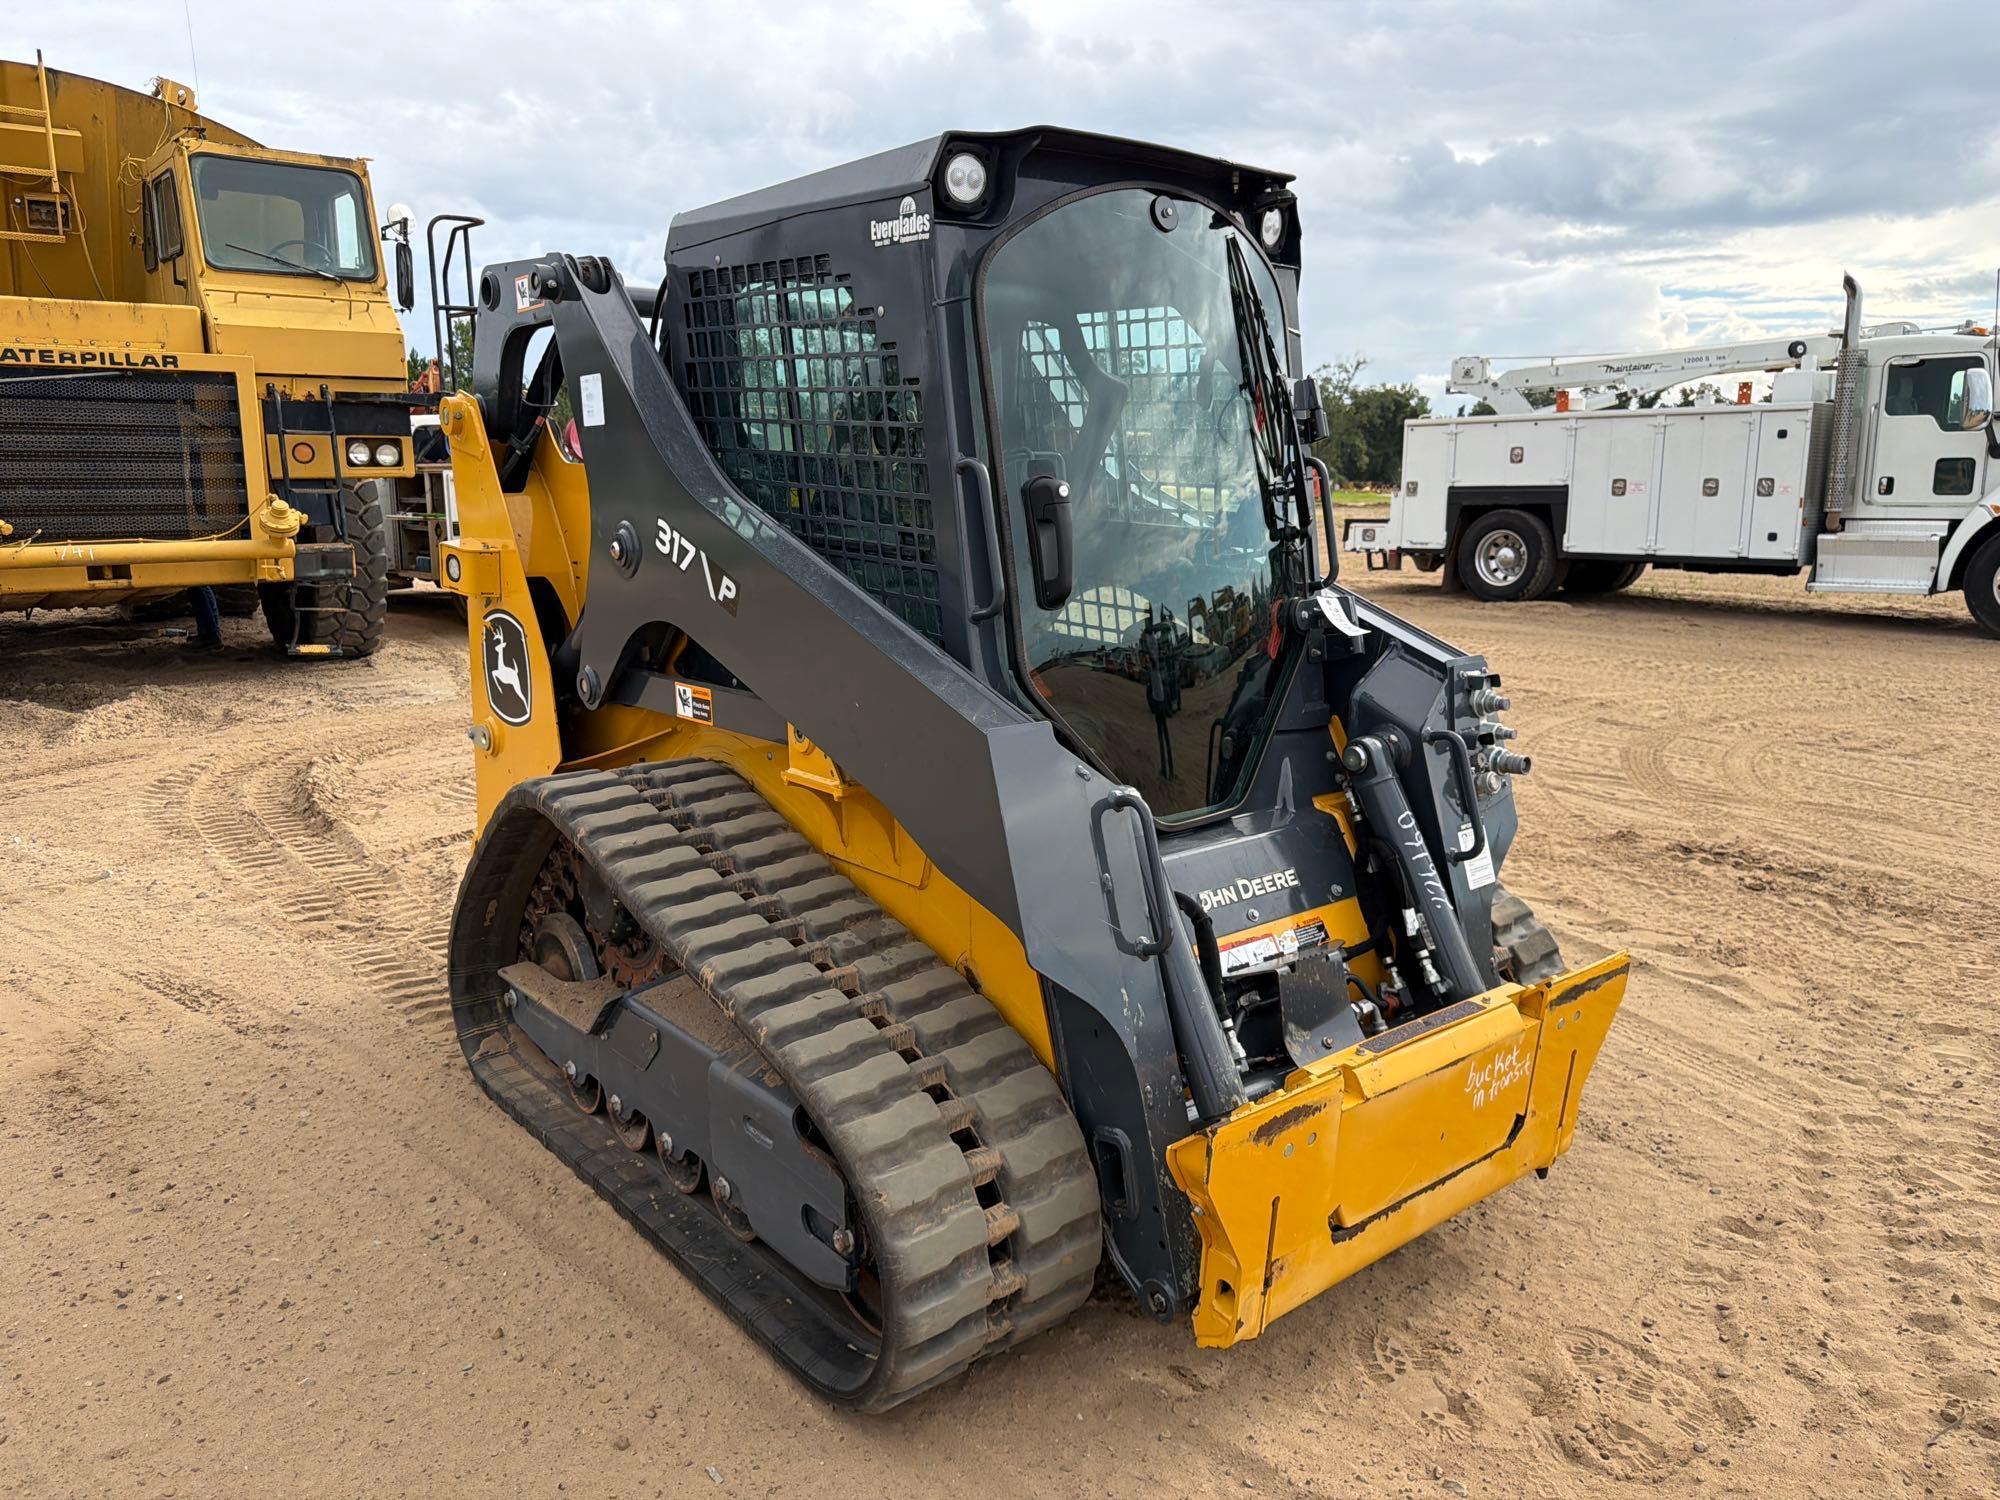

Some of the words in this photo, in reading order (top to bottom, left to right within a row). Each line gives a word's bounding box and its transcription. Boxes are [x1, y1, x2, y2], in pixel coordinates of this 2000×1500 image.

[870, 212, 930, 241] Everglades
[1602, 362, 1656, 374] Maintainer
[1683, 356, 1704, 364] 12000
[655, 518, 696, 571] 317
[1199, 885, 1239, 913] OHN
[1236, 868, 1300, 900] DEERE
[1471, 1088, 1485, 1110] in
